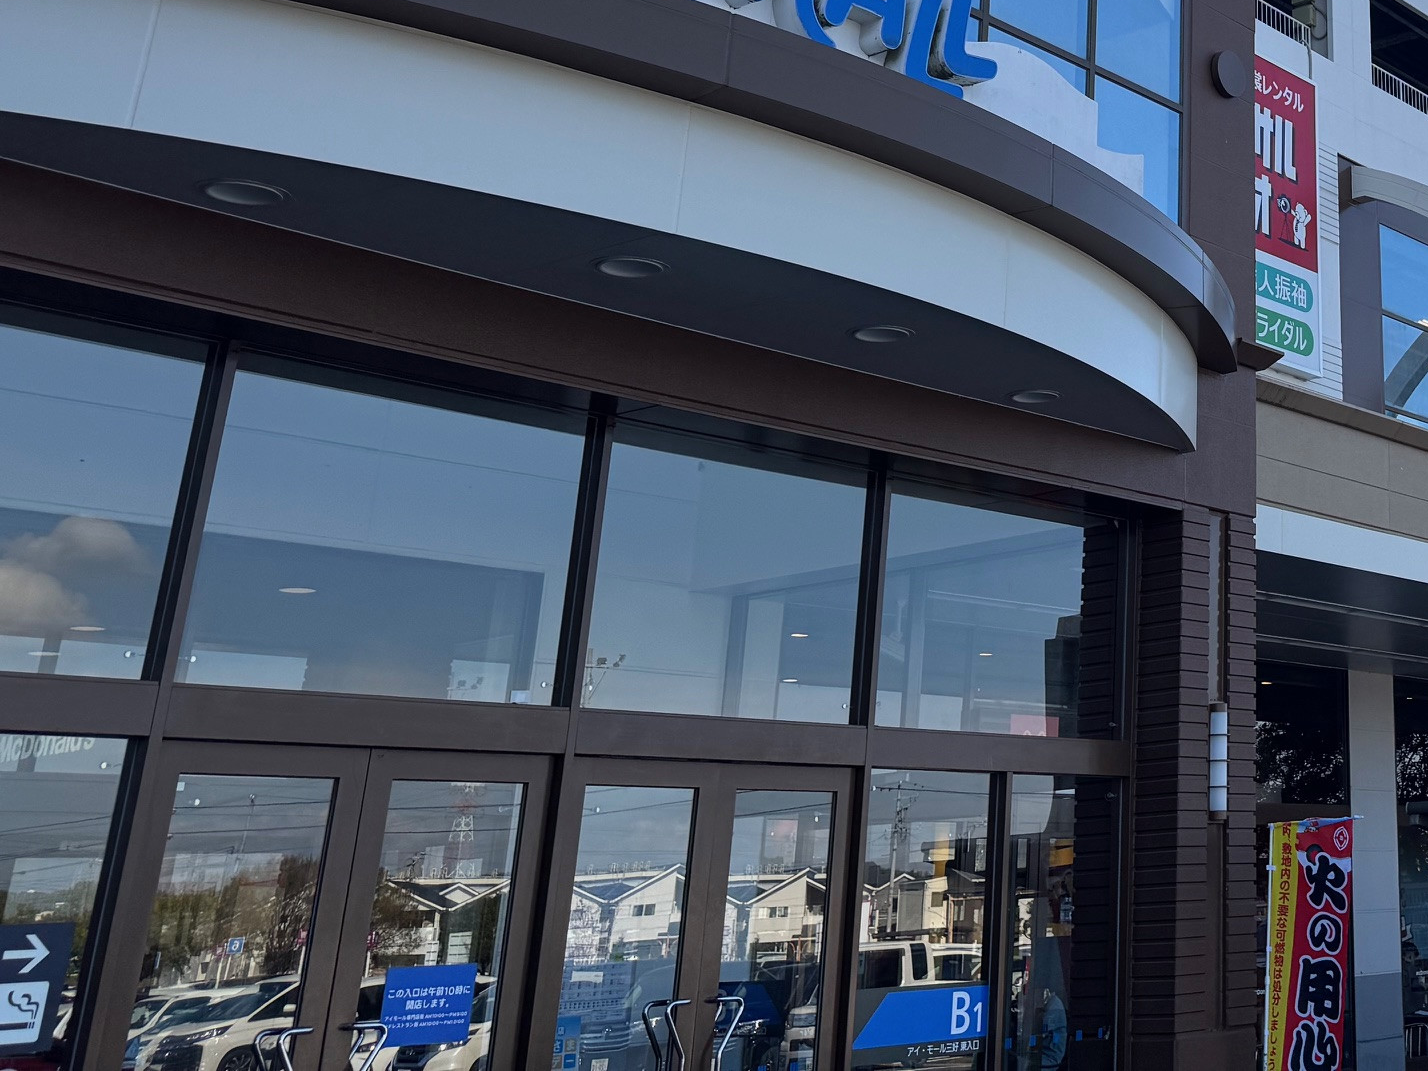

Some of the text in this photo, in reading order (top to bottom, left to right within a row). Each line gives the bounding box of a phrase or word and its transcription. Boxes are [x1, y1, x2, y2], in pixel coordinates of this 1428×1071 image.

[1256, 269, 1307, 309] 人振袖
[1288, 852, 1348, 1071] 火の用心
[388, 985, 471, 998] この入口は午前10時に
[950, 991, 983, 1035] B1
